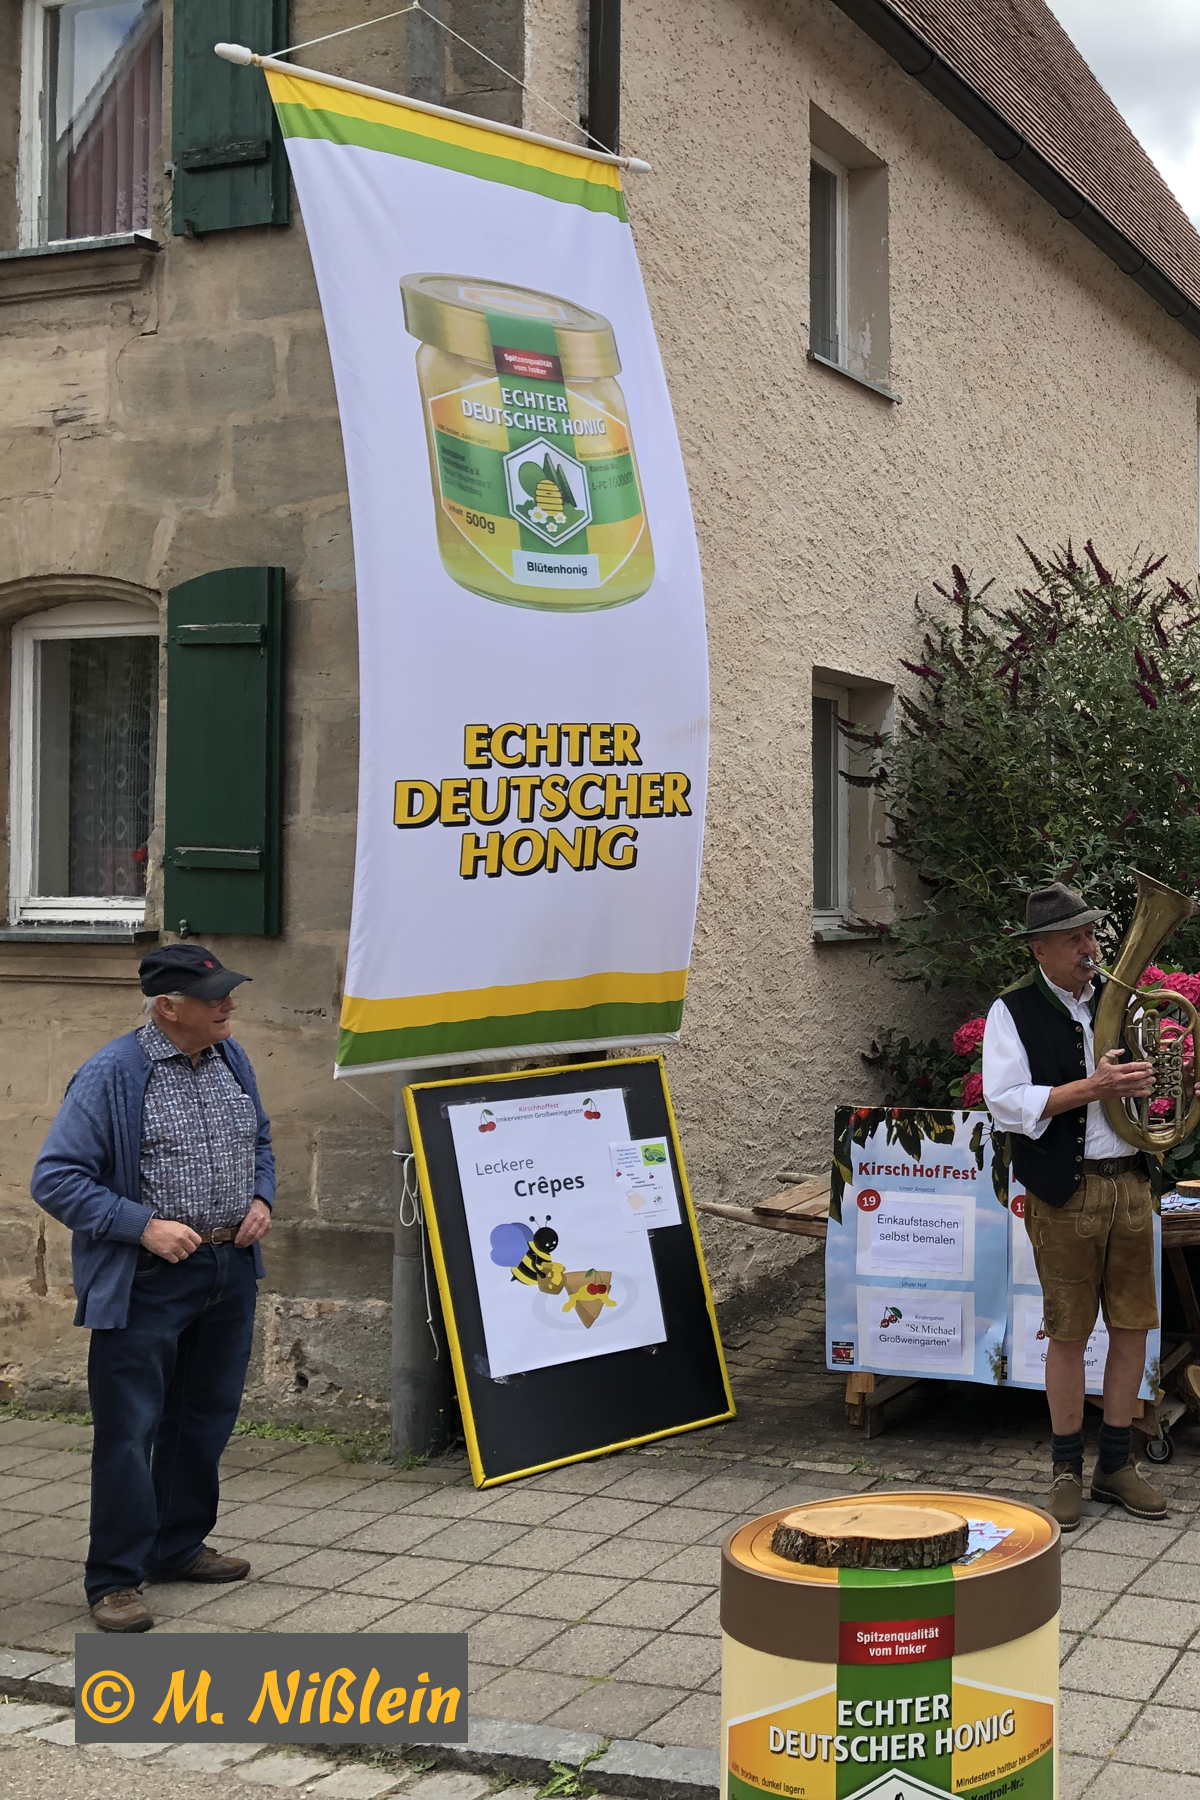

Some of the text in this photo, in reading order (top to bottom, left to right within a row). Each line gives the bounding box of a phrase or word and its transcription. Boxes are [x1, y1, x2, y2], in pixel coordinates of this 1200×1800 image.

[501, 387, 569, 414] ECHTER
[461, 399, 607, 436] DEUTSCHER HONIG
[465, 511, 495, 534] 500g
[526, 560, 588, 576] Blütenhonig
[464, 723, 642, 769] ECHTER
[393, 771, 692, 829] DEUTSCHER
[459, 825, 639, 880] HONIG
[475, 1156, 534, 1176] Leckere
[514, 1174, 585, 1198] Crêpes
[862, 1196, 876, 1207] 19
[877, 1213, 959, 1229] Einkaufstaschen
[879, 1230, 956, 1245] selbst bemalen
[921, 1325, 956, 1336] Michael
[856, 1627, 939, 1645] Spitzenqualität
[869, 1643, 927, 1657] vom Imker
[838, 1693, 950, 1727] ECHTER
[768, 1708, 1016, 1763] DEUTSCHER HONIG
[956, 1769, 996, 1789] Mindestens
[997, 1759, 1018, 1775] haltbar
[1018, 1755, 1027, 1766] bis
[761, 1776, 782, 1791] dunkel
[783, 1782, 805, 1795] lagern
